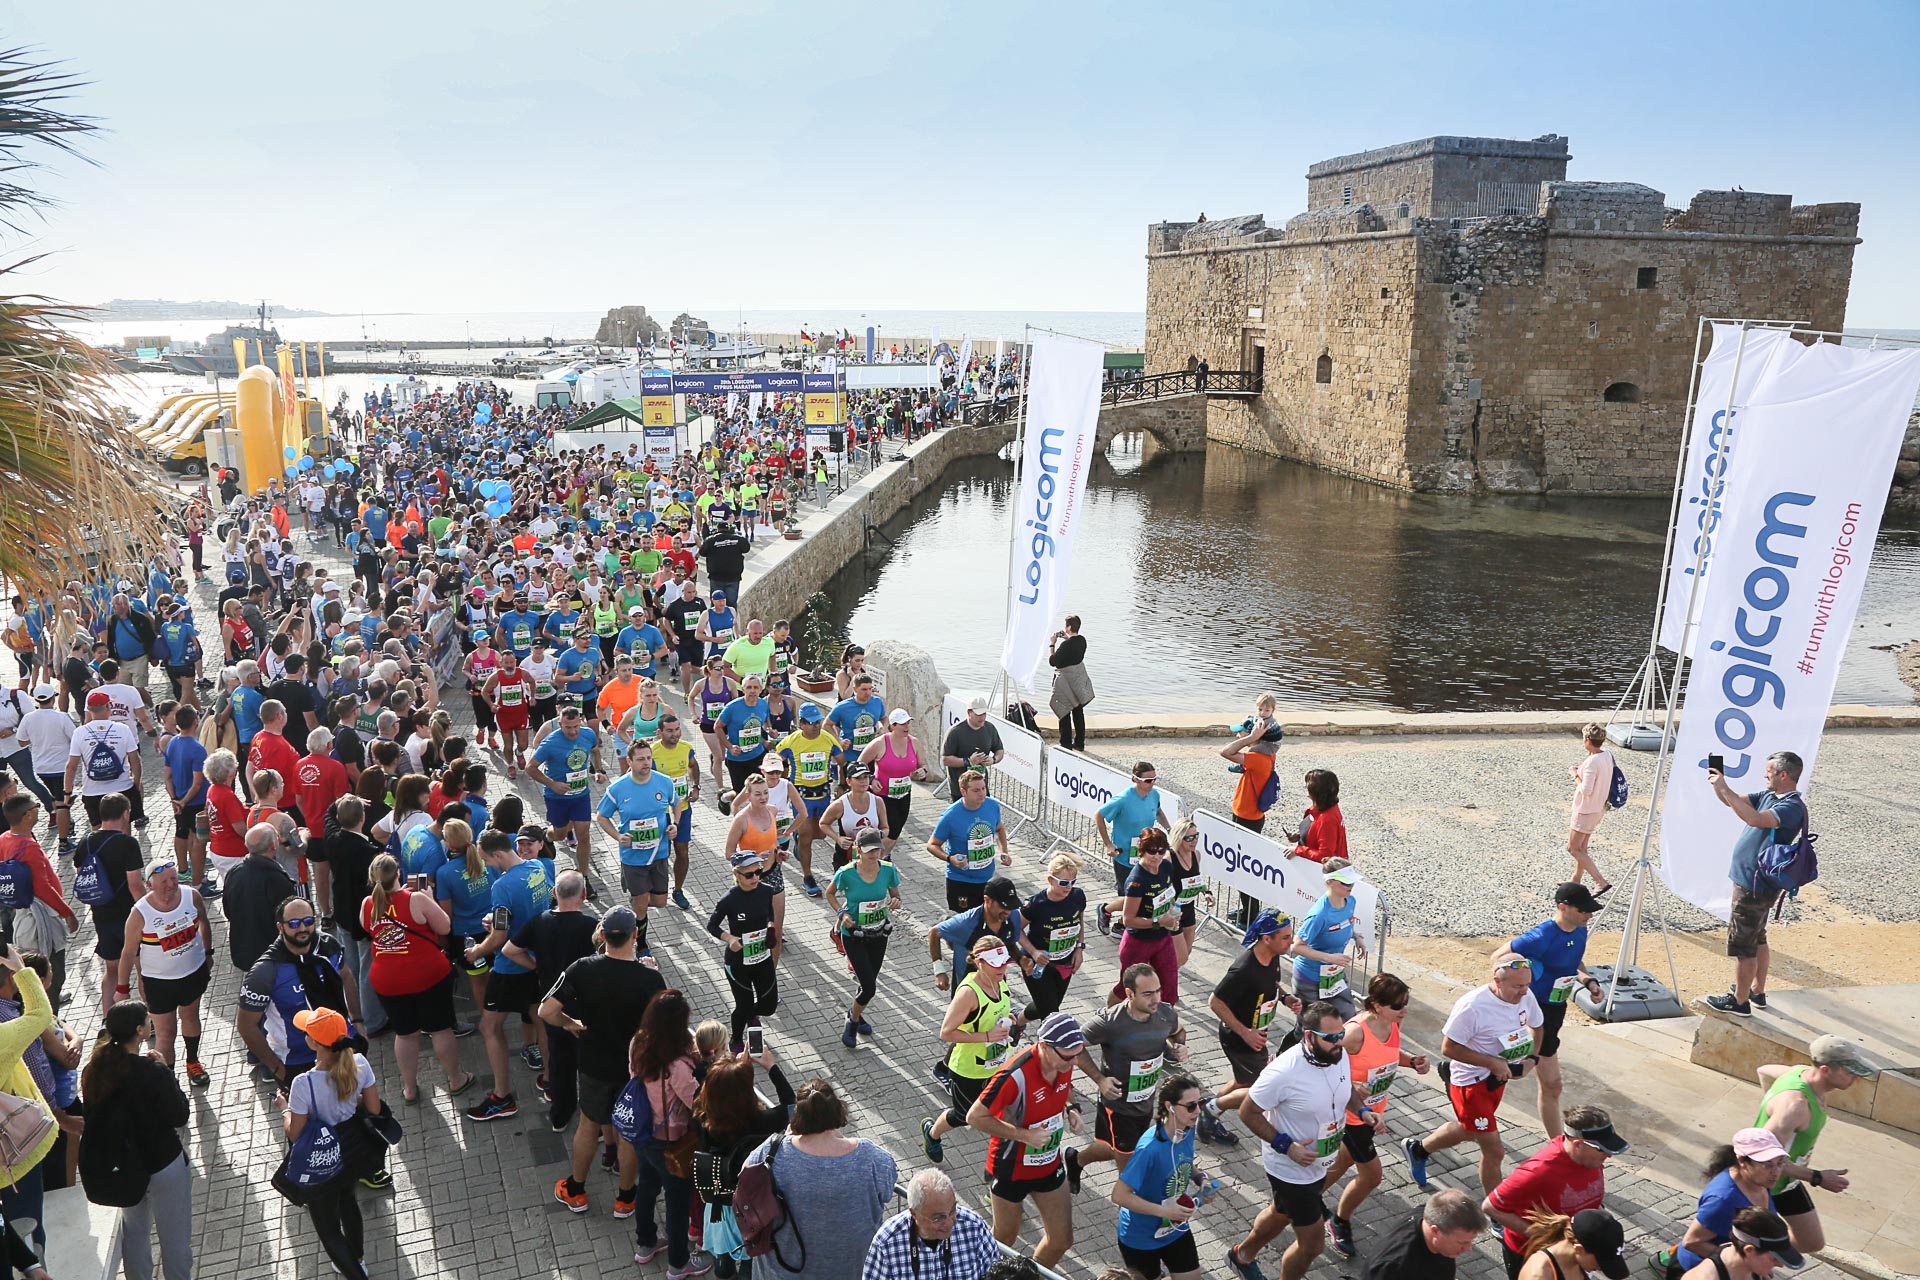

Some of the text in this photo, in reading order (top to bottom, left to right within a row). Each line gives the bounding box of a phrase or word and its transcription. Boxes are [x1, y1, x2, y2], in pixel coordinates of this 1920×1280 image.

[645, 383, 669, 391] Logicom
[675, 381, 705, 389] Logicom
[768, 378, 798, 387] Logicom
[807, 380, 832, 388] Logicom
[1059, 433, 1085, 537] #runwithlogicom
[1019, 428, 1065, 605] Logicom
[1797, 501, 1862, 674] #runwithlogicom
[1698, 490, 1816, 779] Logicom
[743, 736, 760, 747] 1299
[805, 761, 823, 772] 1742
[1055, 766, 1113, 803] Logicom
[633, 829, 657, 843] 1241
[973, 847, 993, 860] 1230
[1204, 832, 1284, 889] Logicom
[164, 930, 193, 949] 2134
[171, 945, 194, 957] Logicom
[748, 941, 767, 955] 164
